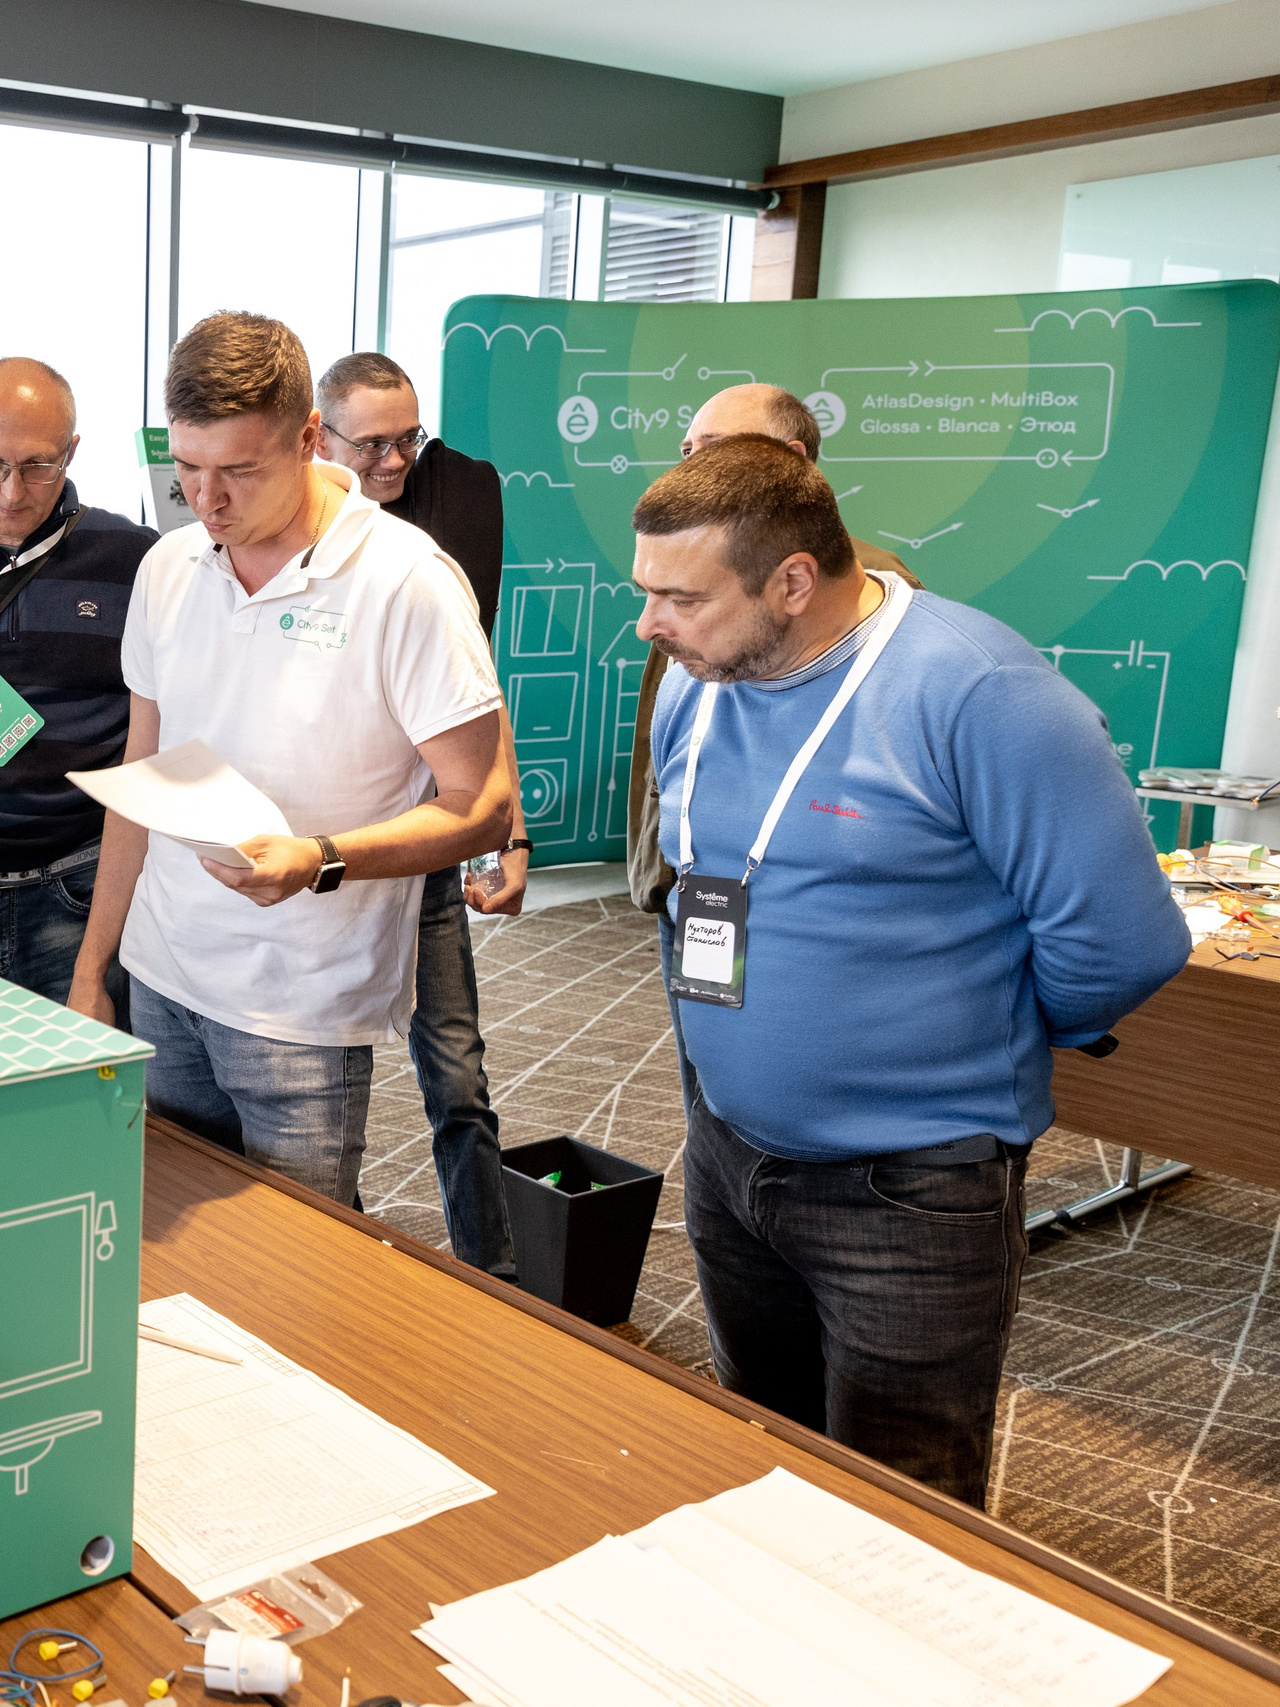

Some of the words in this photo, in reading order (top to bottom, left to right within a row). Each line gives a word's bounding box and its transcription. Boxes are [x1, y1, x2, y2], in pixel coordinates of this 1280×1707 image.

[861, 393, 975, 411] AtlasDesign
[990, 391, 1078, 407] MultiBox
[610, 406, 670, 434] City9
[860, 418, 920, 434] Glossa
[938, 417, 1000, 433] Blanca
[1020, 416, 1076, 434] Этюд
[297, 619, 319, 632] City9
[320, 623, 336, 634] Set
[695, 890, 729, 902] Systême
